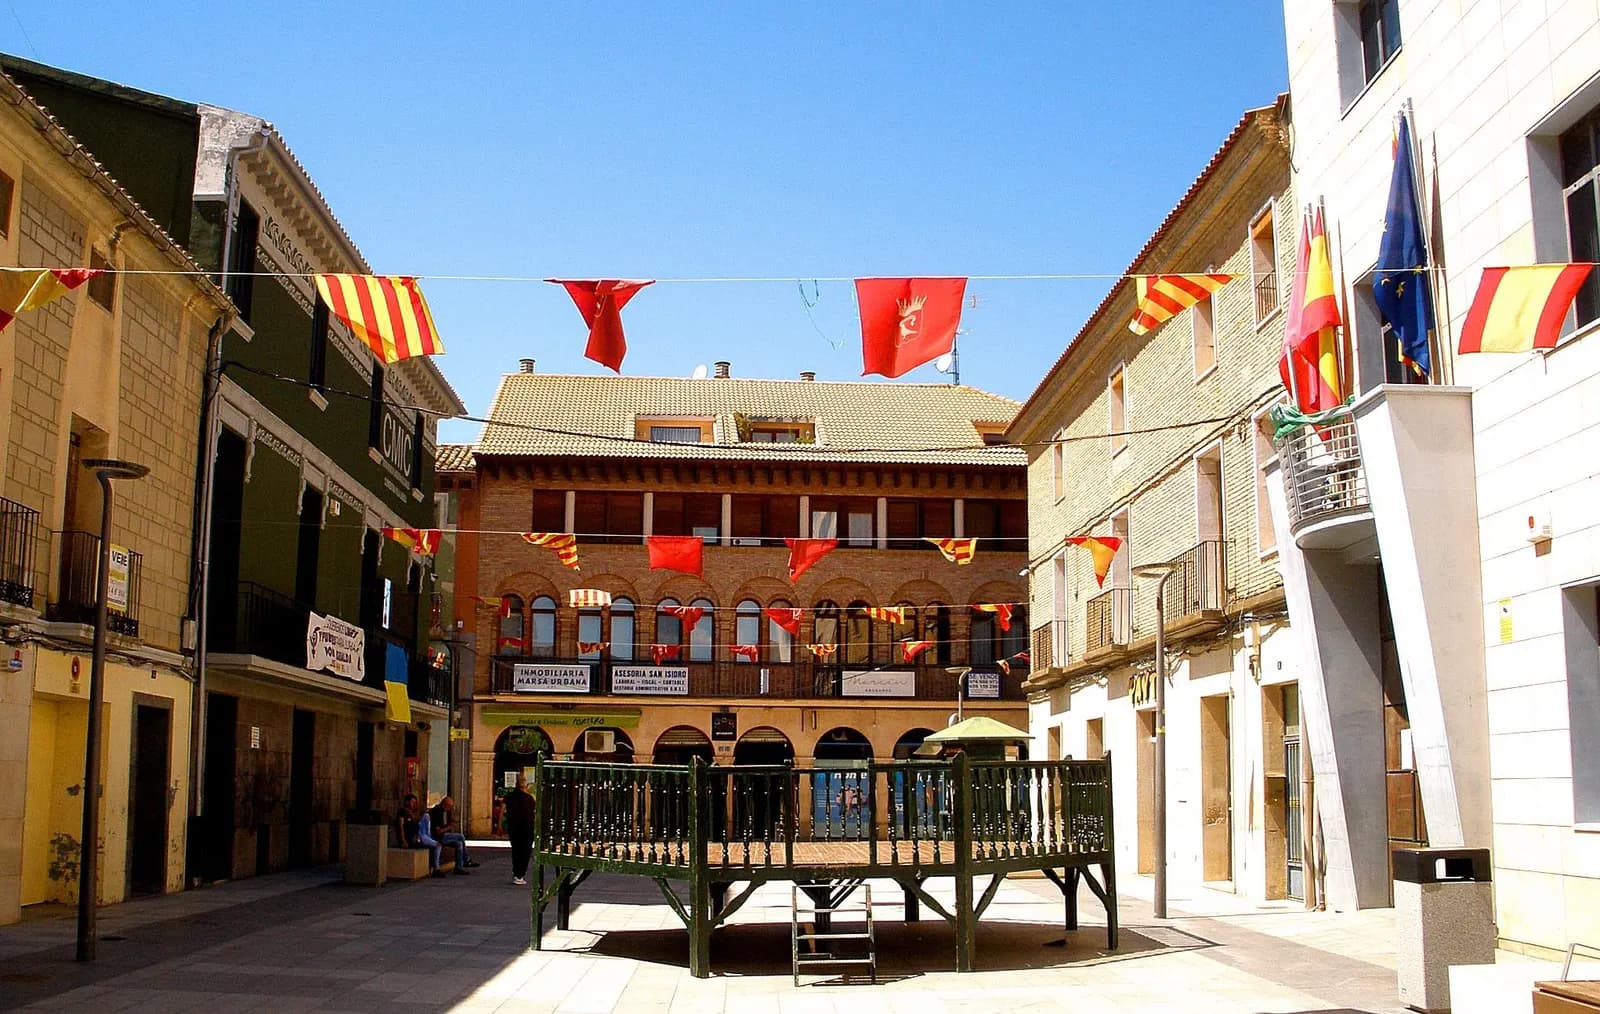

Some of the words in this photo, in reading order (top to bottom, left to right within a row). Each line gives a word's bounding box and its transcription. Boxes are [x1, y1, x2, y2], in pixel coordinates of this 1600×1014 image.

[520, 669, 584, 677] INMOBILIARIA
[614, 670, 646, 678] ASESORIA
[649, 670, 662, 678] SAN
[665, 670, 686, 678] ISIDRO
[550, 678, 587, 686] URBANA
